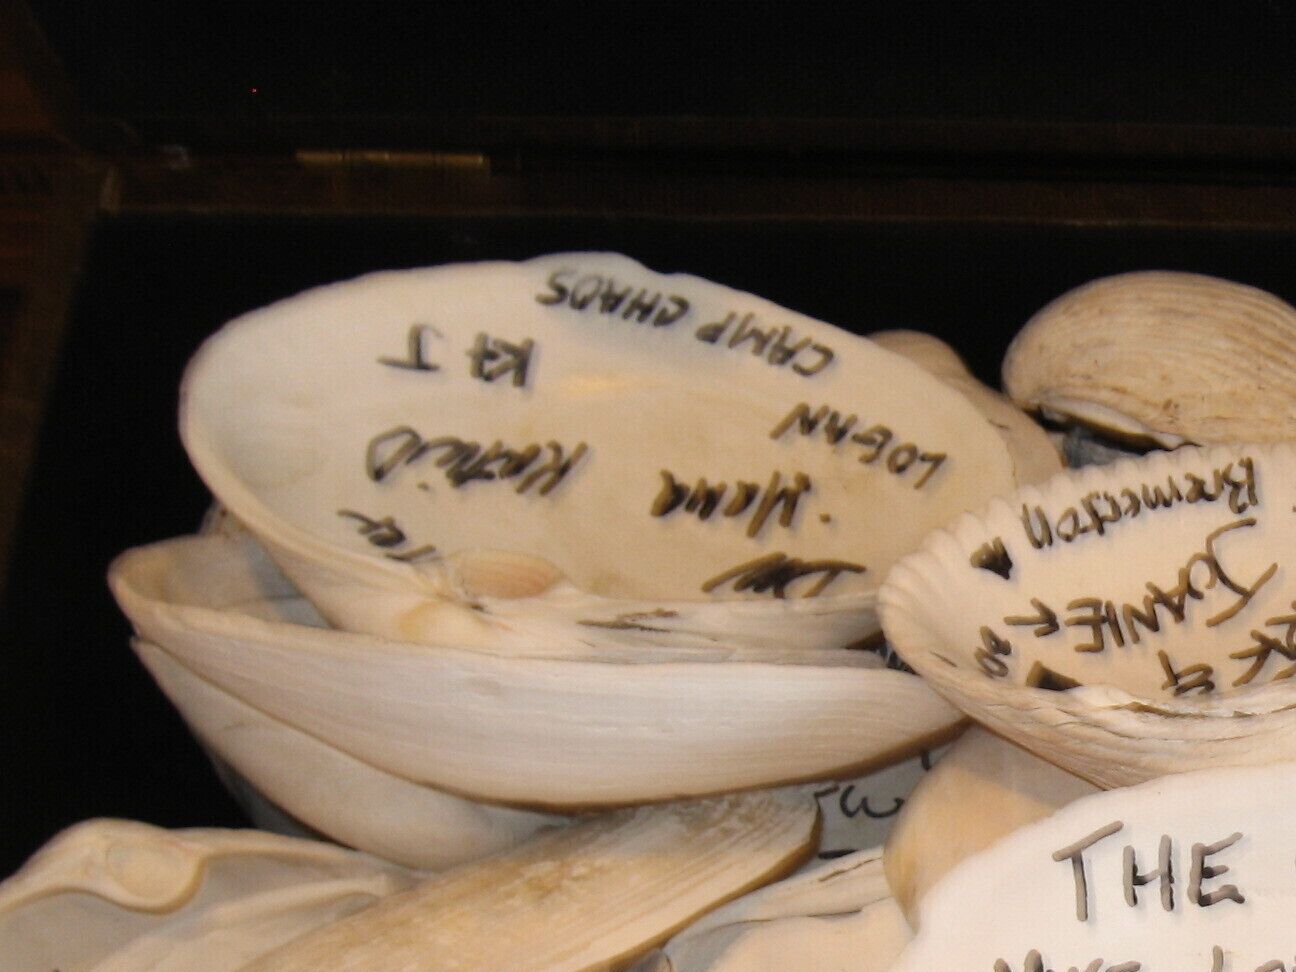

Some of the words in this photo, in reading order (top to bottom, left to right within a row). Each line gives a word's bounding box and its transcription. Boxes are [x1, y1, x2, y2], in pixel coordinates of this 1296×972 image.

[537, 266, 691, 329] CHAOS
[697, 318, 836, 378] CAMP
[769, 401, 948, 491] LOGAN
[1021, 458, 1258, 548] Bremerton
[1052, 820, 1245, 922] THE
